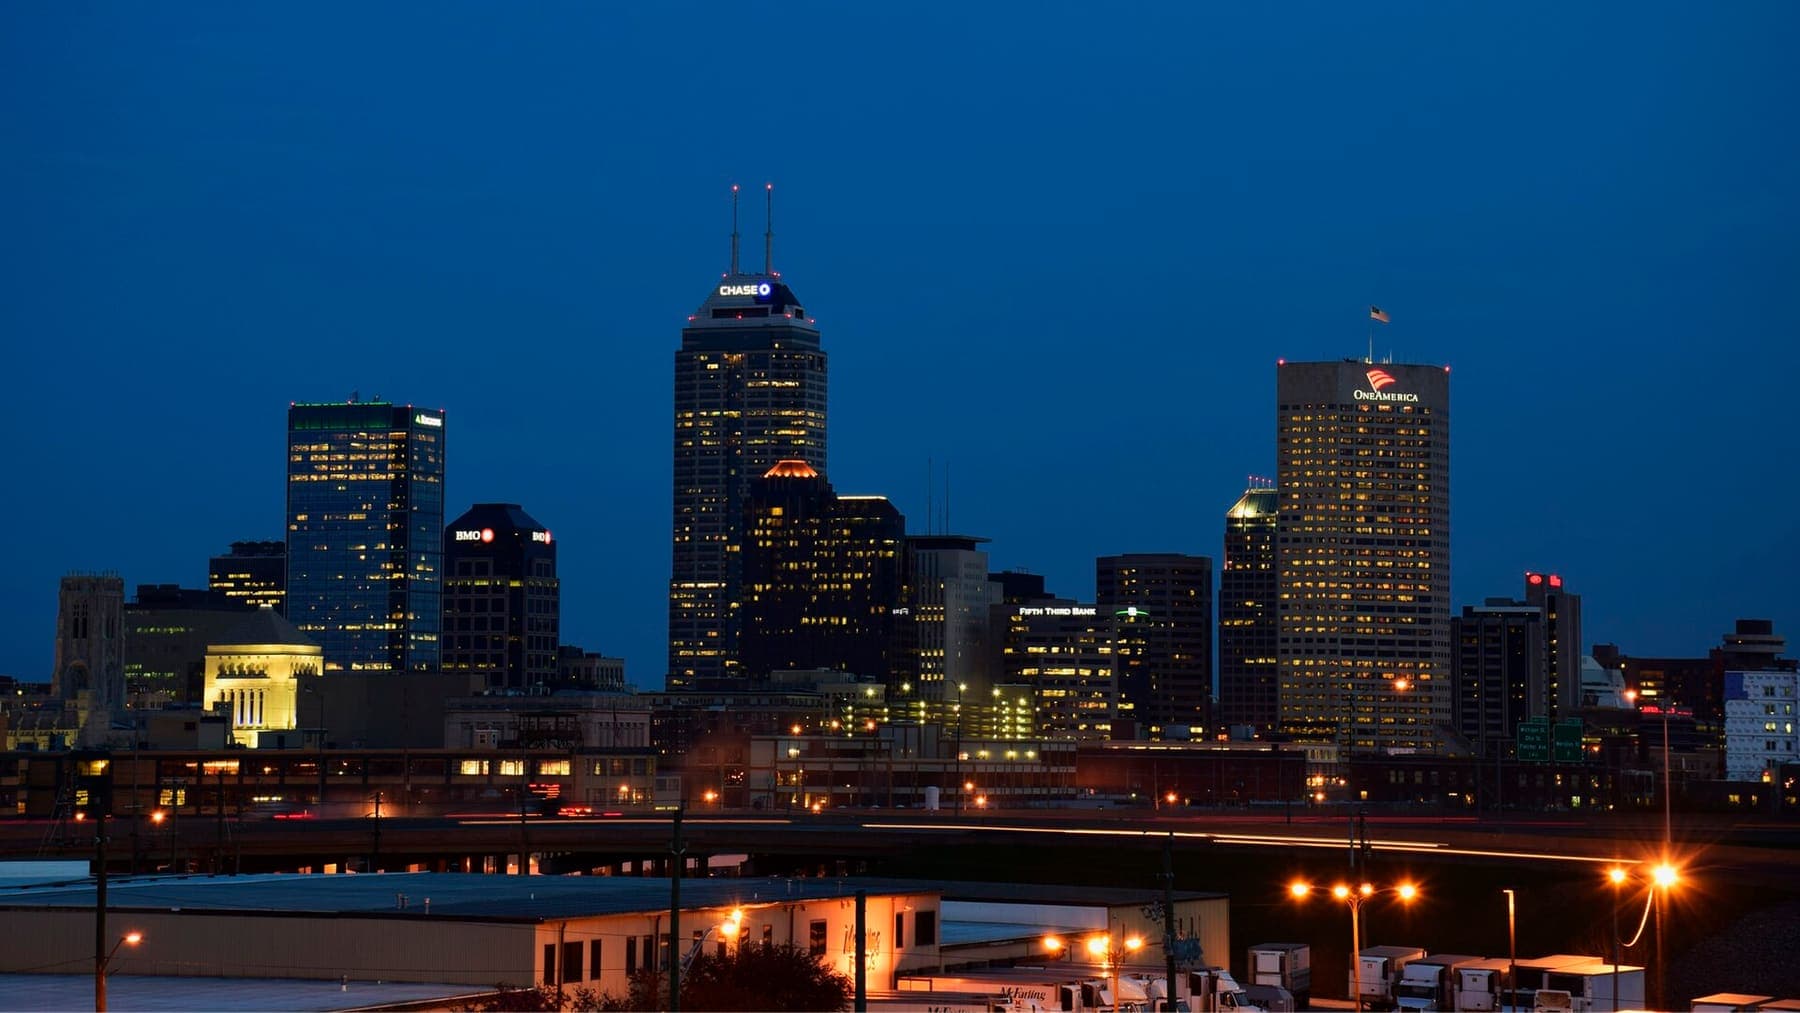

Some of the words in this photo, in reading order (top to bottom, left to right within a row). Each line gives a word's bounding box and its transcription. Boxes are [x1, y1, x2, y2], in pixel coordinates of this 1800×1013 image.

[720, 285, 758, 296] CHASE
[456, 531, 481, 541] BMO
[1019, 607, 1043, 616] FIFTH
[1044, 607, 1071, 616] THIRD
[1072, 607, 1096, 616] BANK
